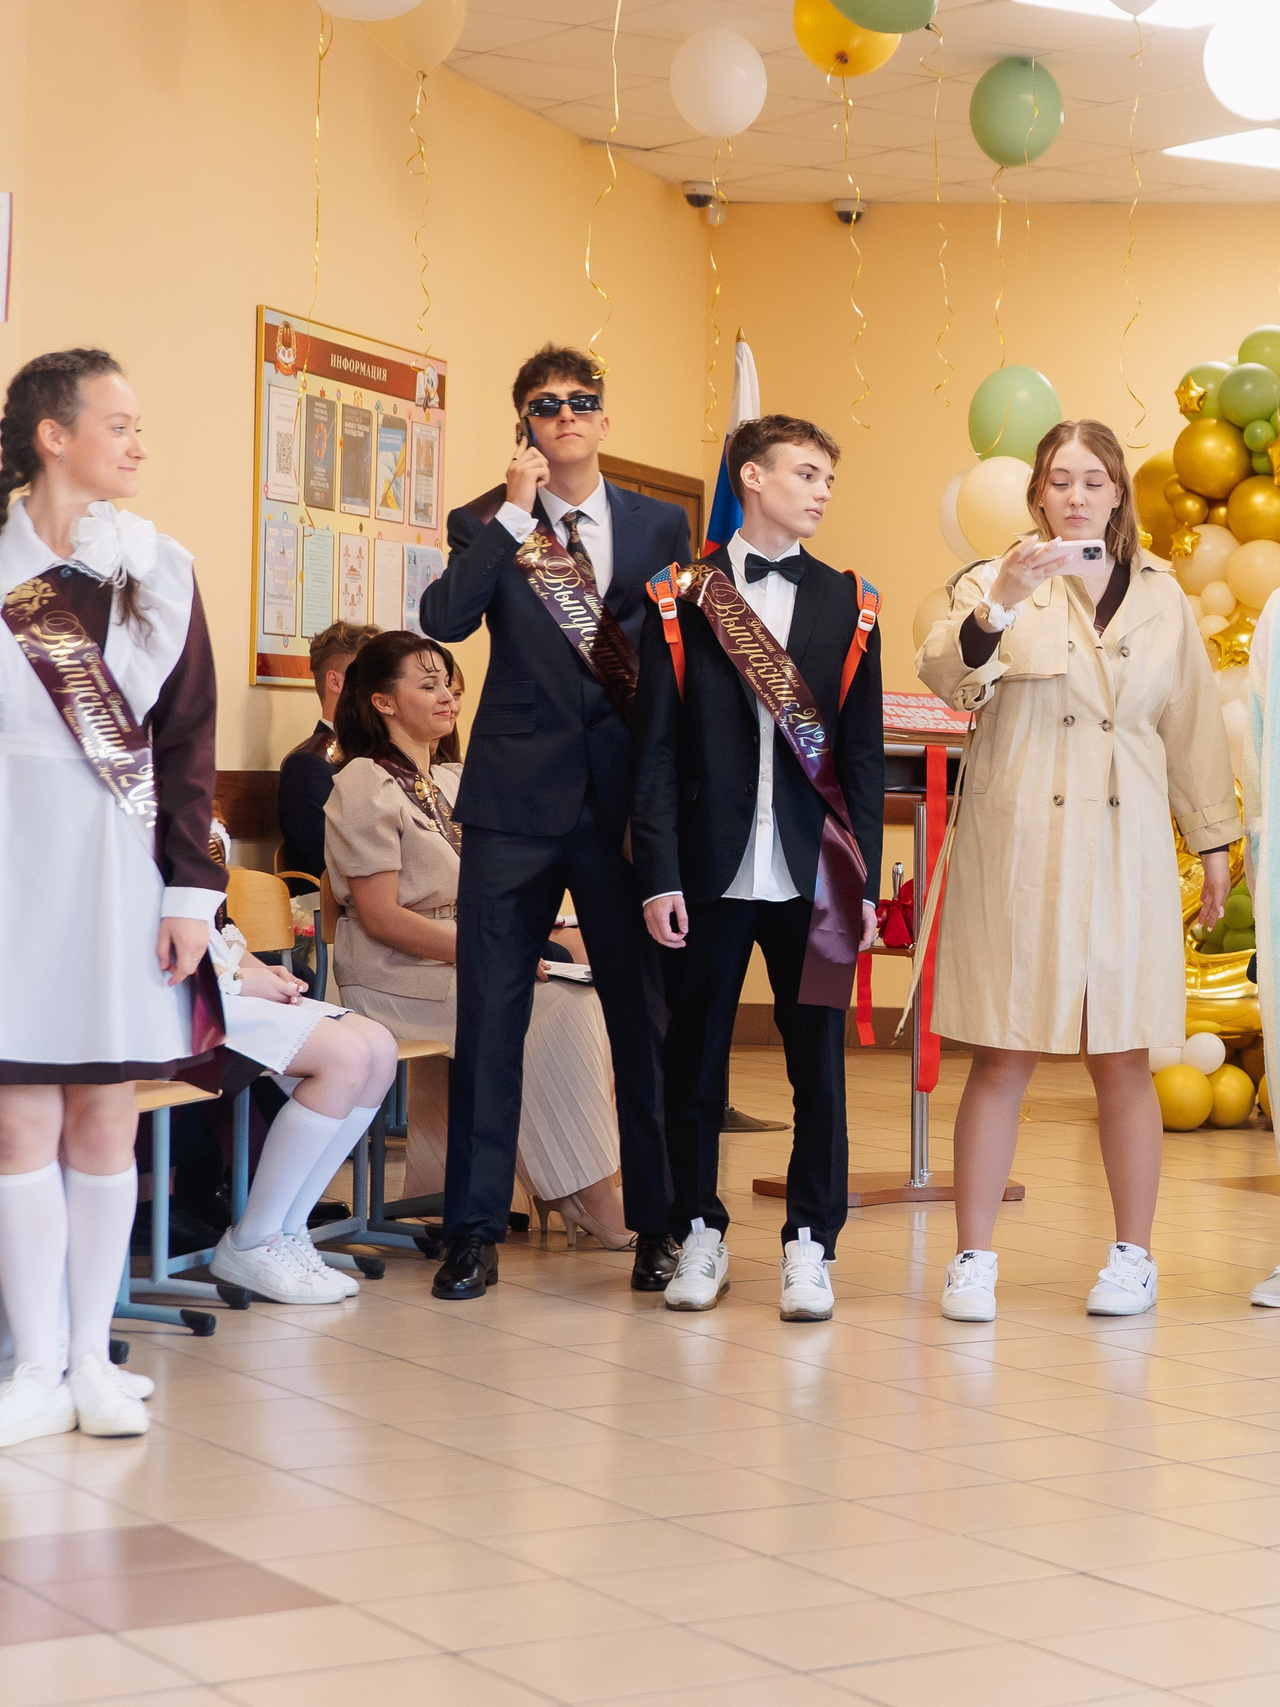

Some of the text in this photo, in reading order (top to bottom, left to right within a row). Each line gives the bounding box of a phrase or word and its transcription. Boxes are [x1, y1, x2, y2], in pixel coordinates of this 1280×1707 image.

[330, 353, 387, 381] ИНФОРМАЦИЯ
[30, 610, 136, 768] Выпускница
[704, 582, 830, 761] Выпускник 2024
[743, 667, 762, 691] Школа
[773, 654, 799, 689] Кирилл
